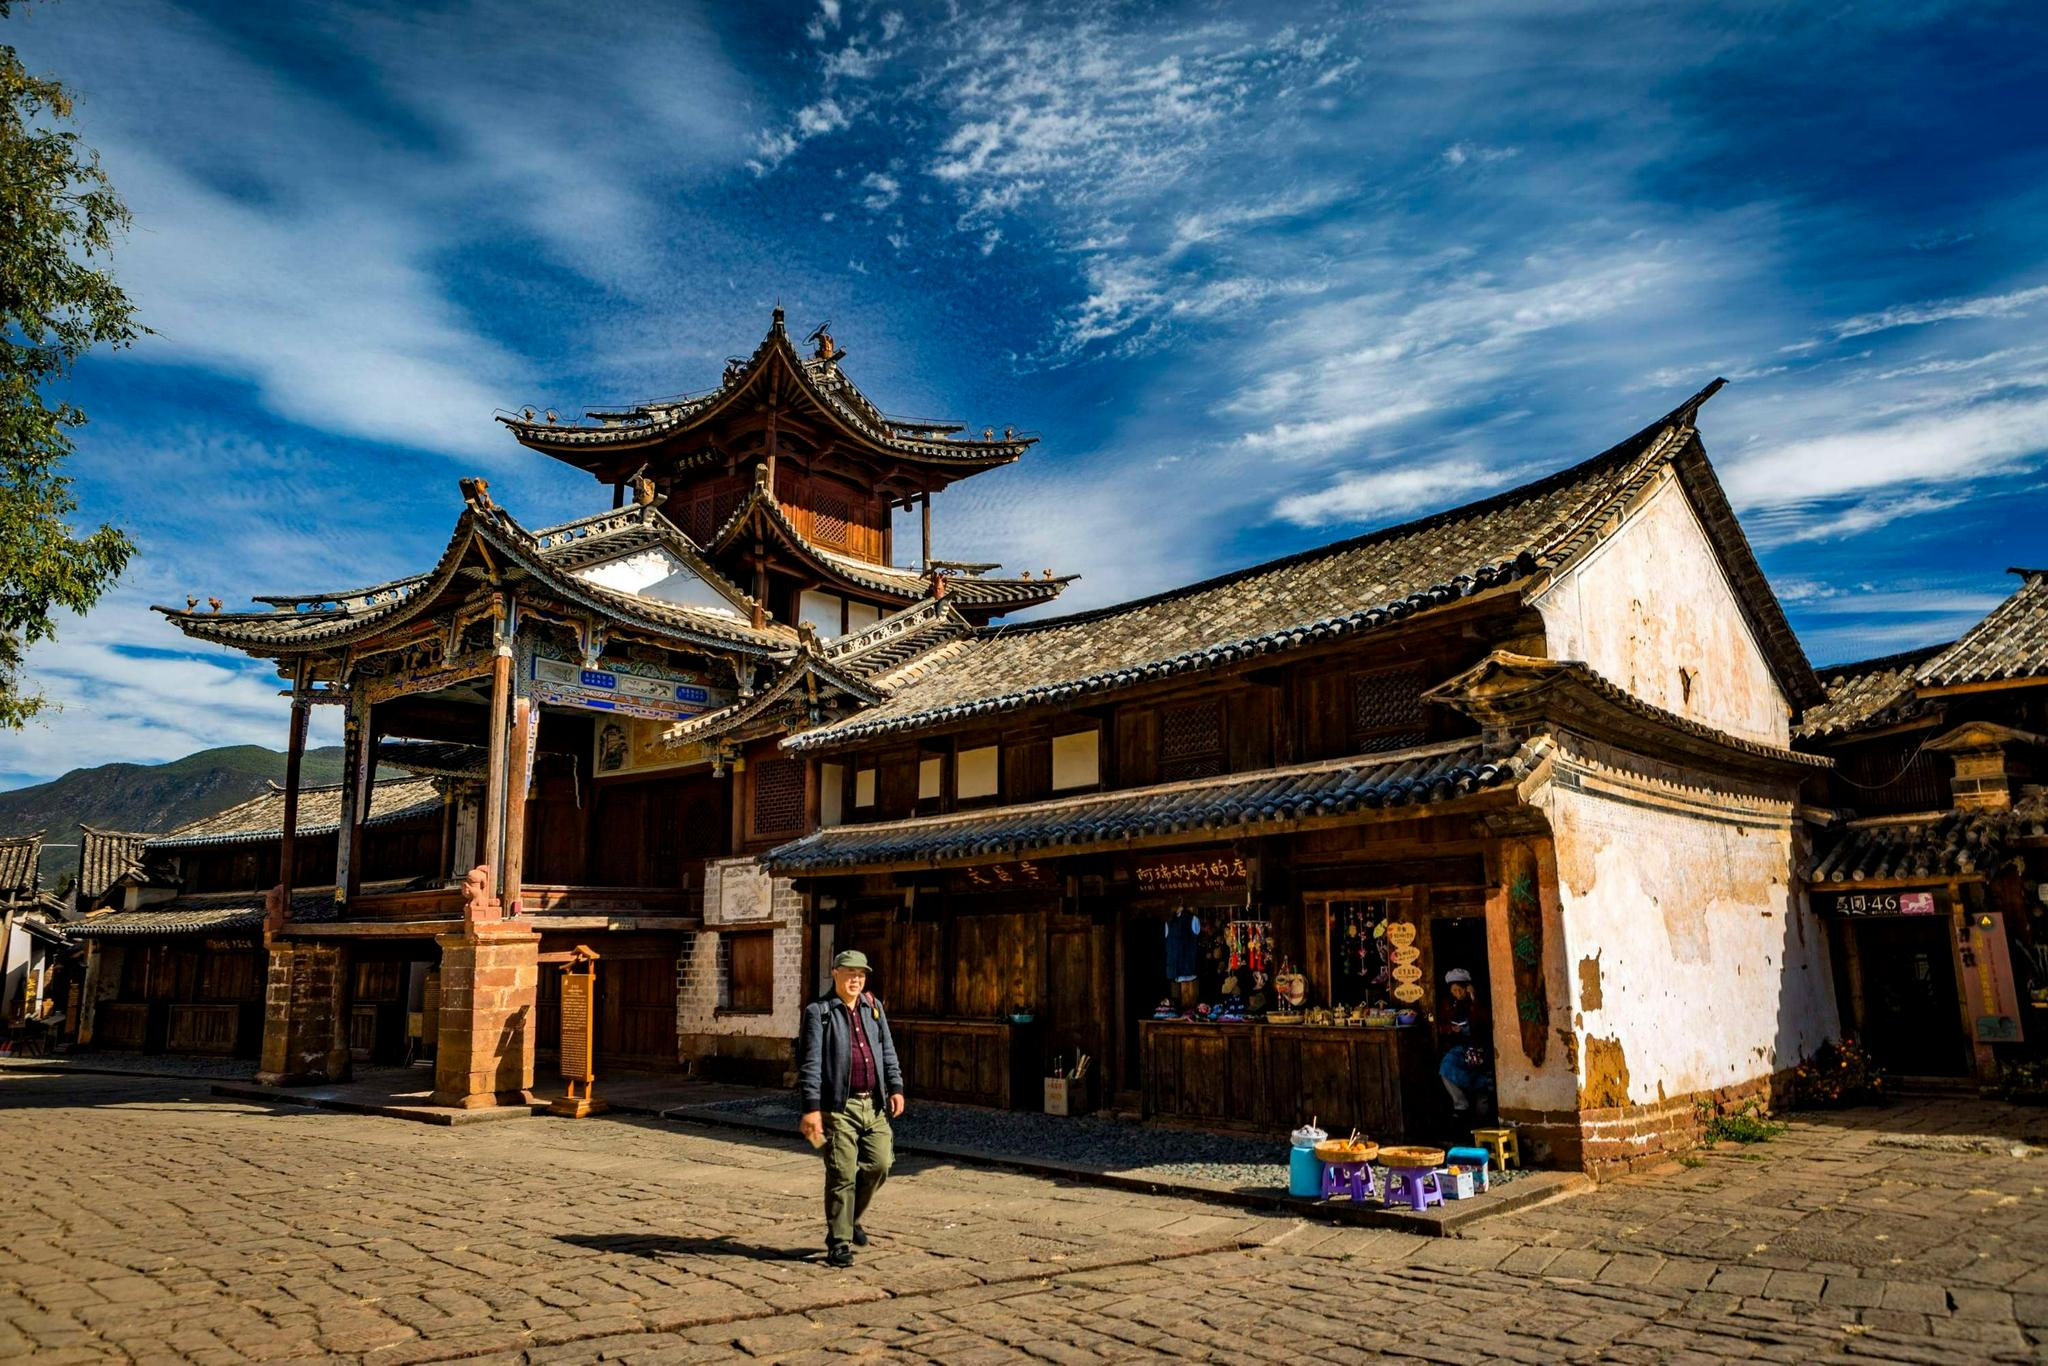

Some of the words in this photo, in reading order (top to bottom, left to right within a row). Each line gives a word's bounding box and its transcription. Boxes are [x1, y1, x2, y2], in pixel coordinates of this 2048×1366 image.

[1136, 858, 1247, 882] 阿瑞奶奶的店
